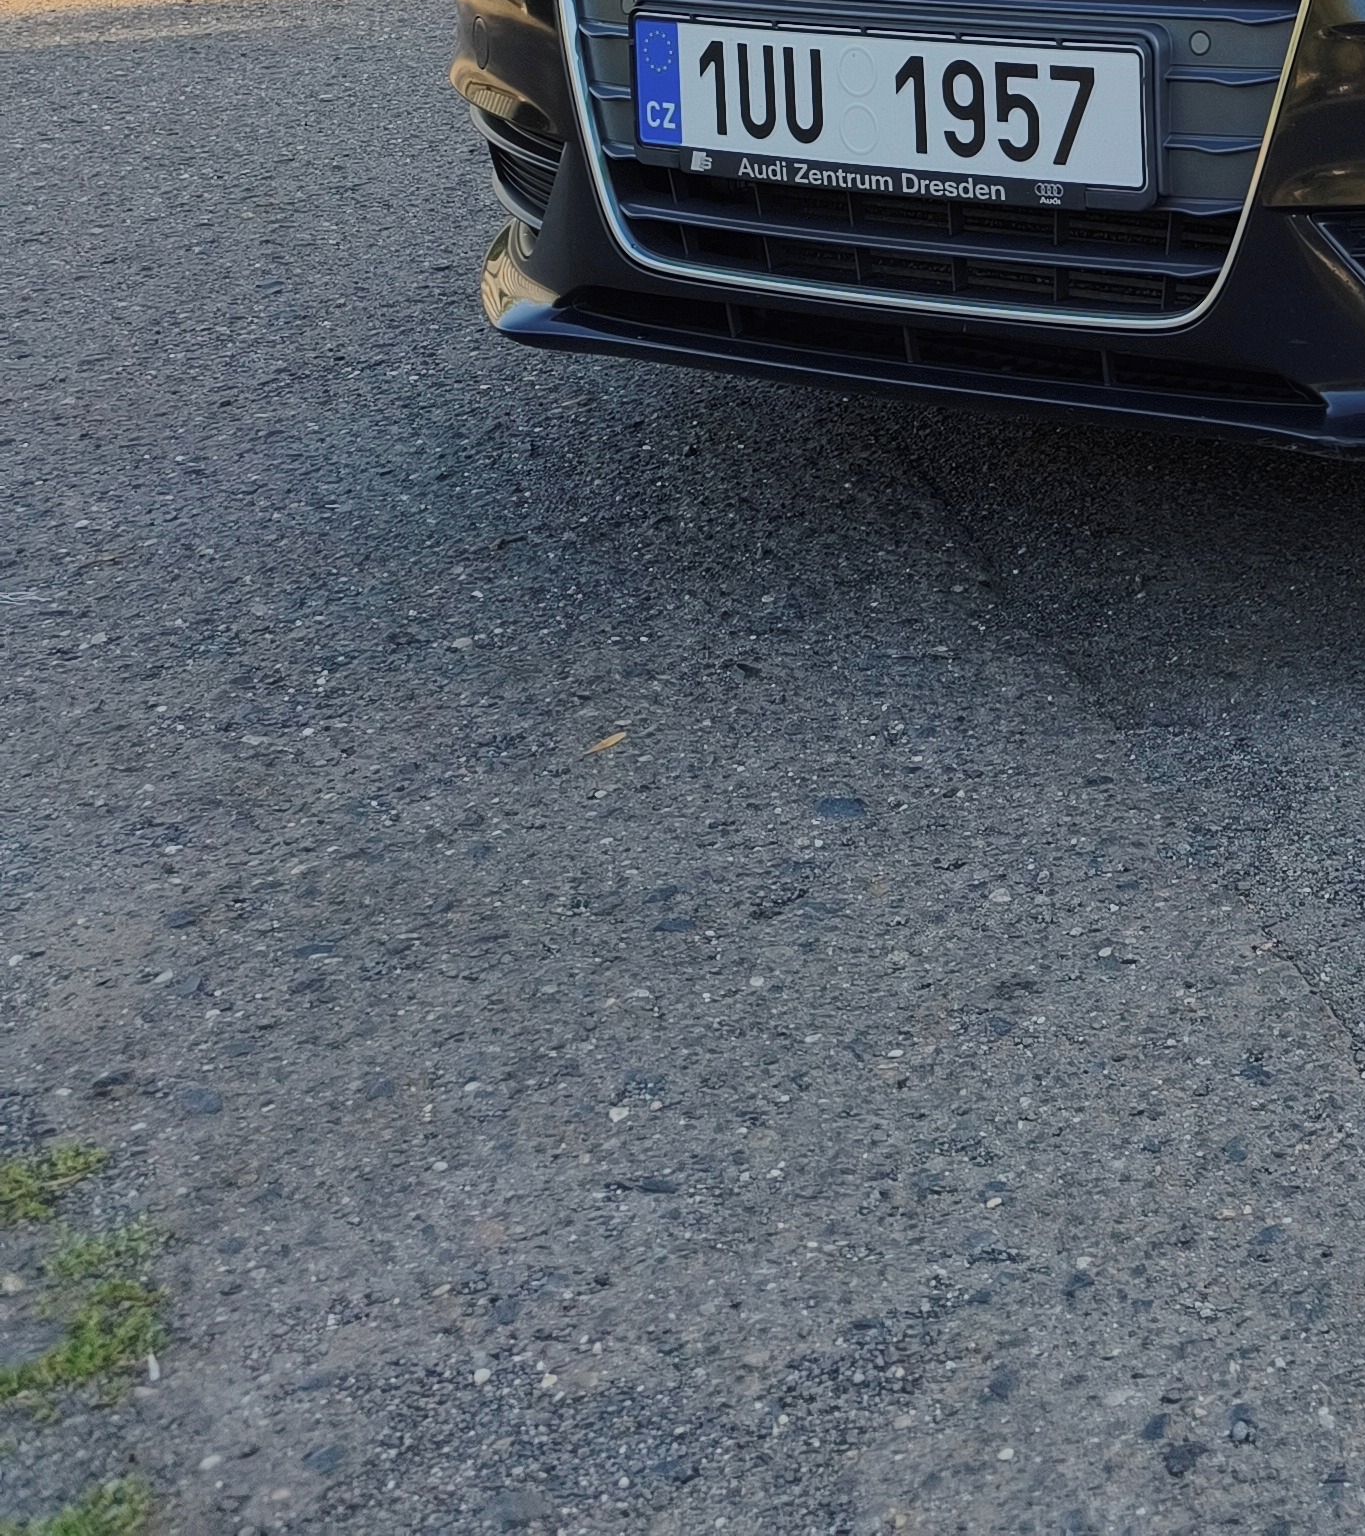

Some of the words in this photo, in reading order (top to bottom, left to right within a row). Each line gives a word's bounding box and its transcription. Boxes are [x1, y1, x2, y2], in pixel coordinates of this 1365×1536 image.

[646, 101, 677, 130] CZ
[699, 40, 823, 144] 1UU
[895, 56, 1095, 166] 1957
[738, 157, 788, 182] Audi
[794, 163, 893, 192] Zentrum
[901, 172, 1006, 201] Dresden
[1039, 196, 1062, 205] Audi
